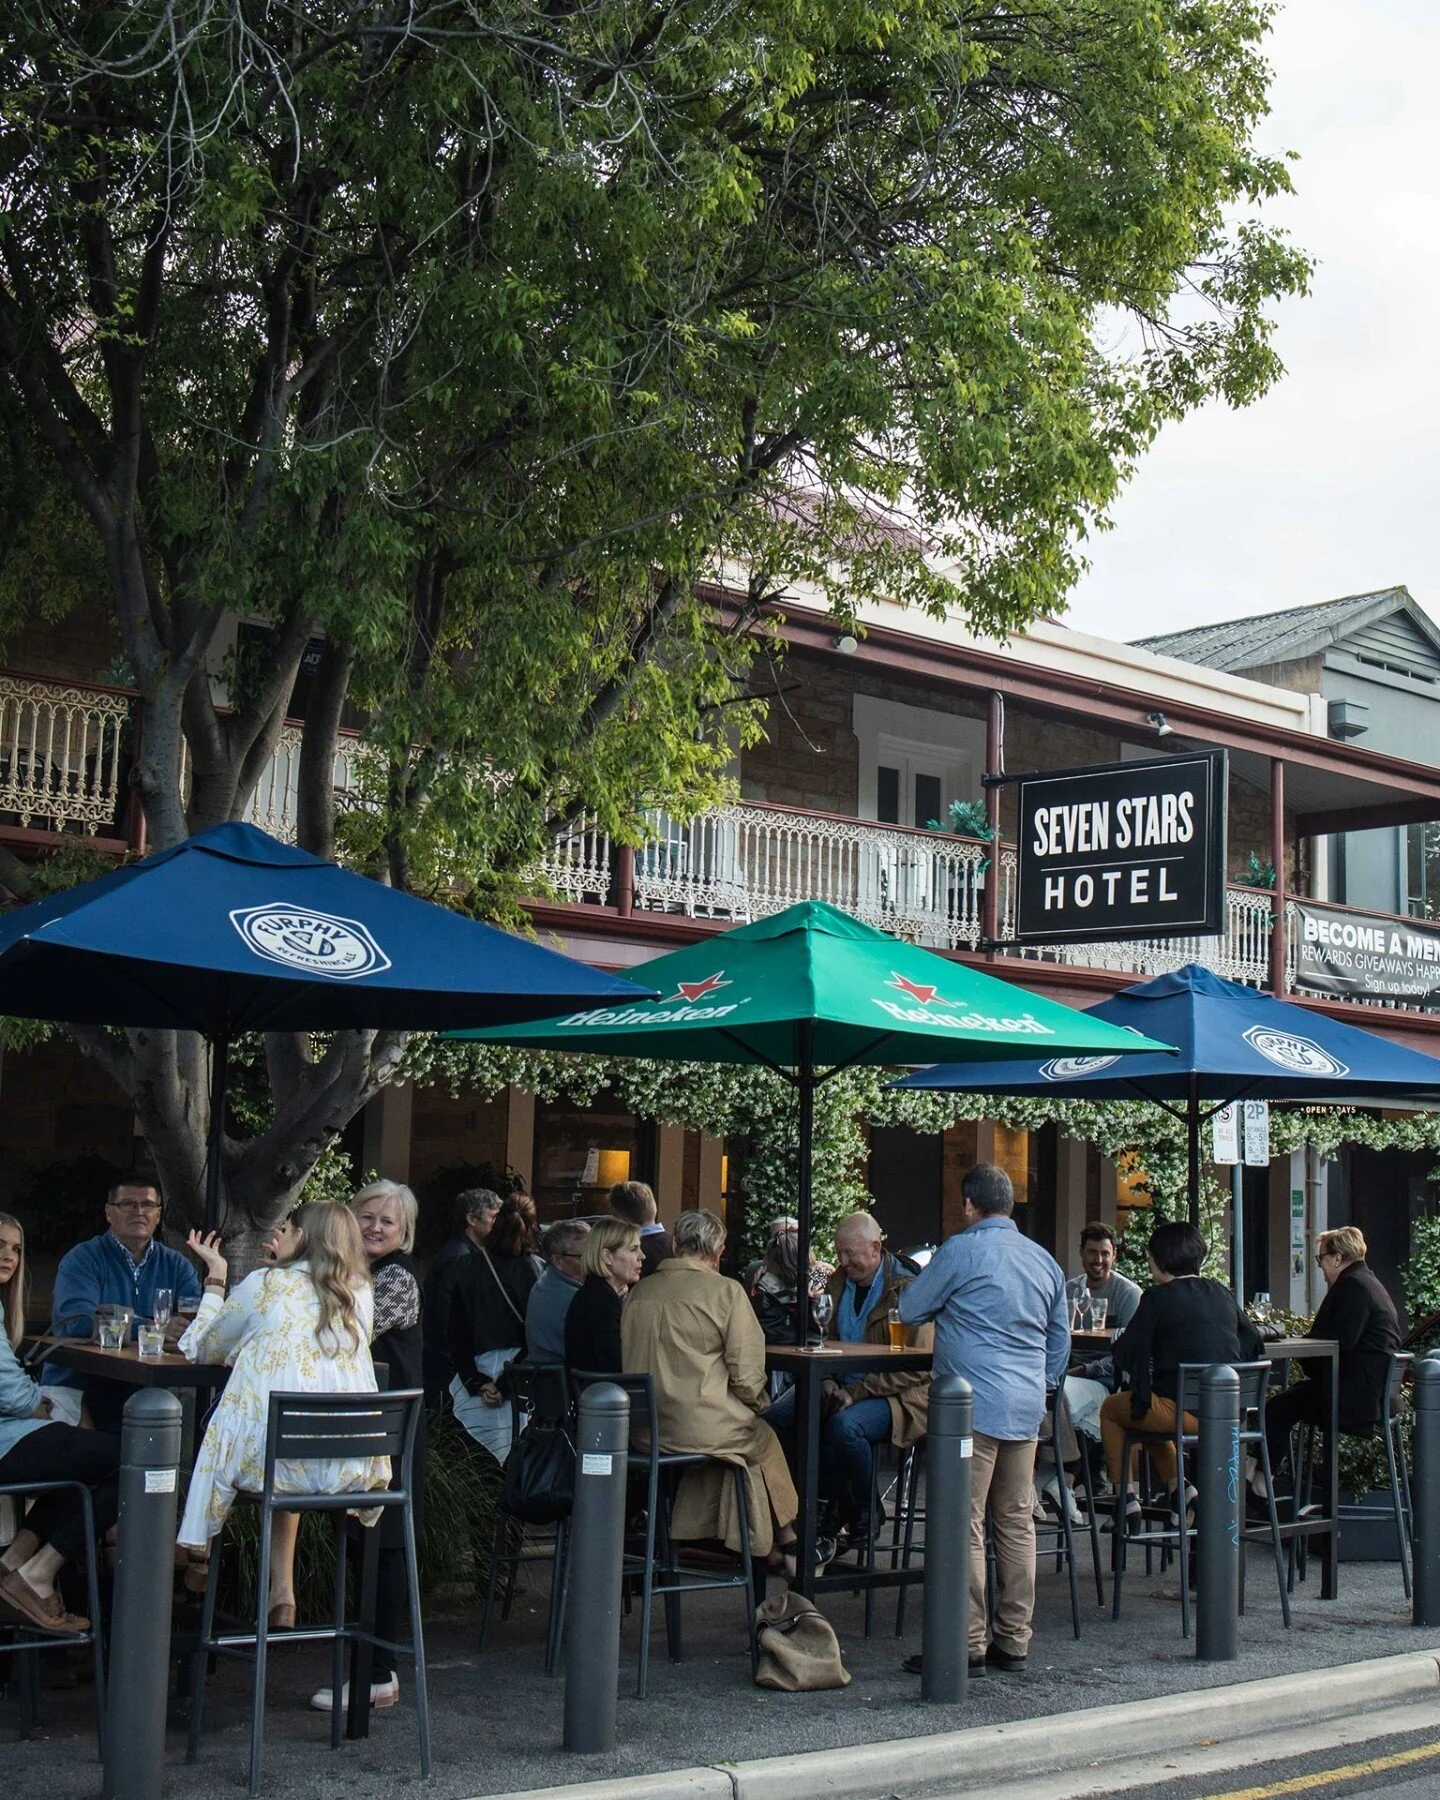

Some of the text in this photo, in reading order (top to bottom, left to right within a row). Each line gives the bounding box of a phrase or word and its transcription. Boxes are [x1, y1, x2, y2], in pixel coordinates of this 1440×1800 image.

[1033, 791, 1194, 857] SEVEN STARS
[1044, 867, 1178, 910] HOTEL
[257, 917, 348, 941] FURPHY
[1304, 916, 1385, 954] BECOME
[1389, 932, 1403, 956] A
[1301, 944, 1352, 968] REWARDS
[1355, 953, 1414, 977] GIVEAWAYS
[1365, 973, 1430, 999] Sign up today!
[556, 1004, 738, 1027] Heineken
[871, 998, 1056, 1035] Heineken
[1246, 1103, 1265, 1120] 2P
[1305, 1106, 1327, 1114] OPEN
[1328, 1106, 1334, 1114] 7
